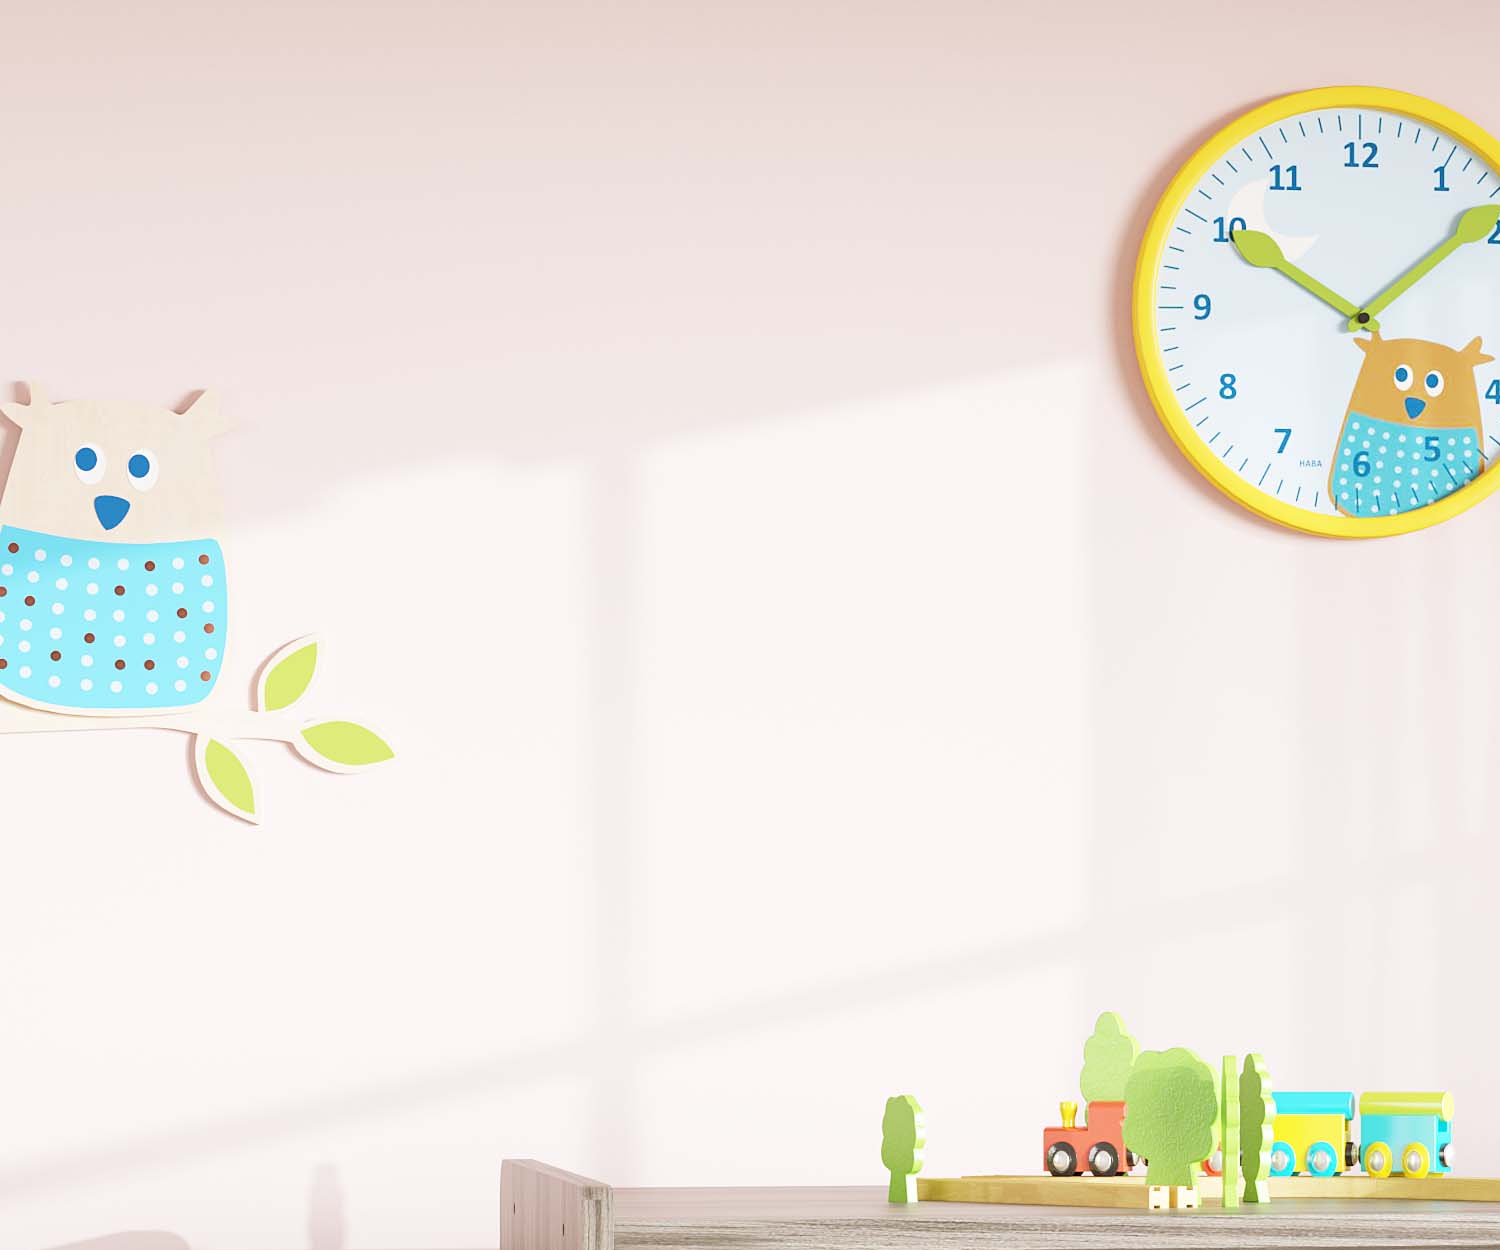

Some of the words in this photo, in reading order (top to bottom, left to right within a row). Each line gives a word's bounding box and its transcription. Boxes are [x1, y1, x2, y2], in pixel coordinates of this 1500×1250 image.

[1344, 142, 1379, 168] 12
[1269, 165, 1302, 191] 11
[1434, 166, 1450, 191] 1
[1213, 216, 1247, 243] 10
[1193, 294, 1211, 320] 9
[1219, 374, 1237, 400] 8
[1274, 428, 1292, 454] 7
[1424, 436, 1441, 462] 5
[1299, 459, 1322, 468] HABA
[1353, 451, 1371, 477] 6
